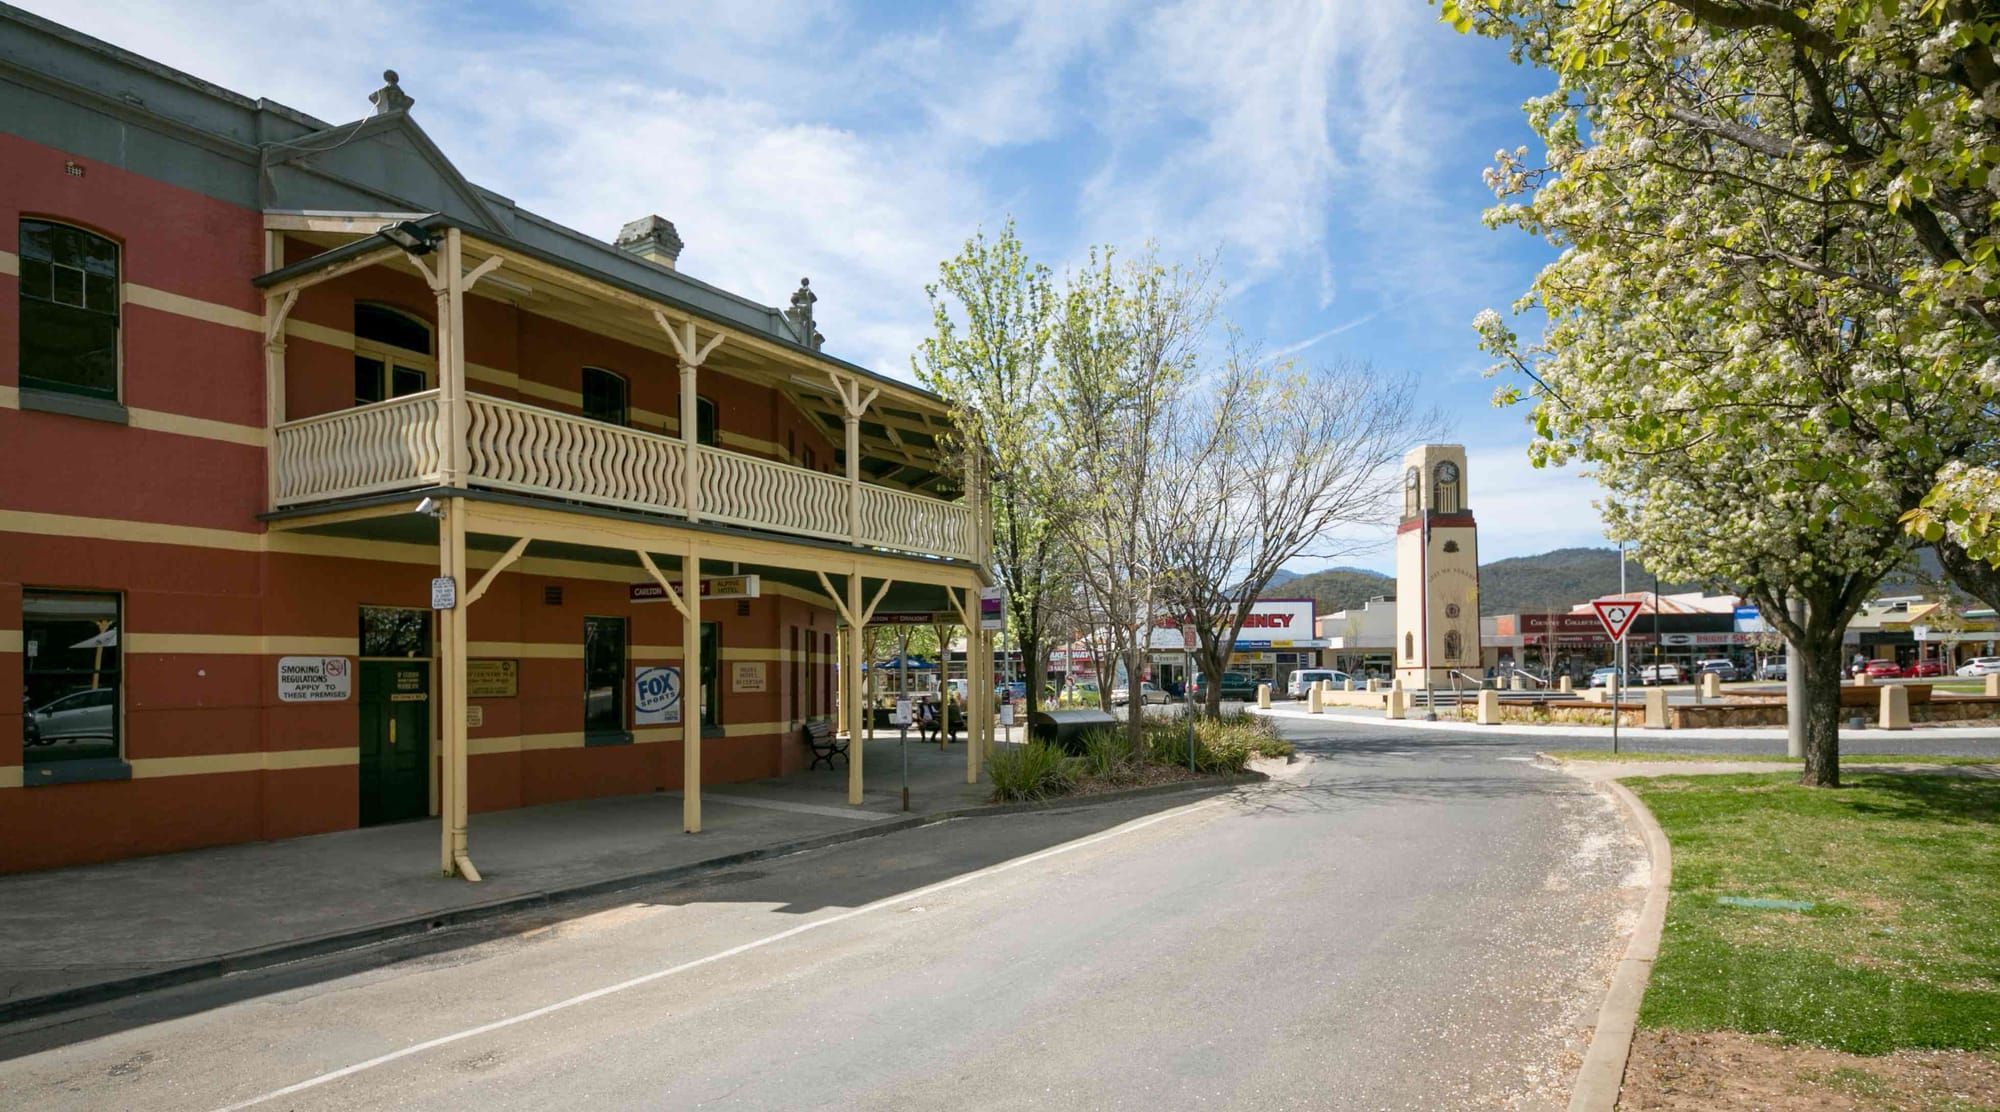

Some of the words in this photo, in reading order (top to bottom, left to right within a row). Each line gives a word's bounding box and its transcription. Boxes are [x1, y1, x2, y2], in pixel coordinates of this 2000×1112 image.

[634, 587, 662, 596] CARLTON
[281, 665, 319, 674] SMOKING
[281, 675, 327, 683] REGULATIONS
[638, 672, 674, 700] FOX
[284, 691, 306, 699] THESE
[641, 691, 676, 707] SPORTS
